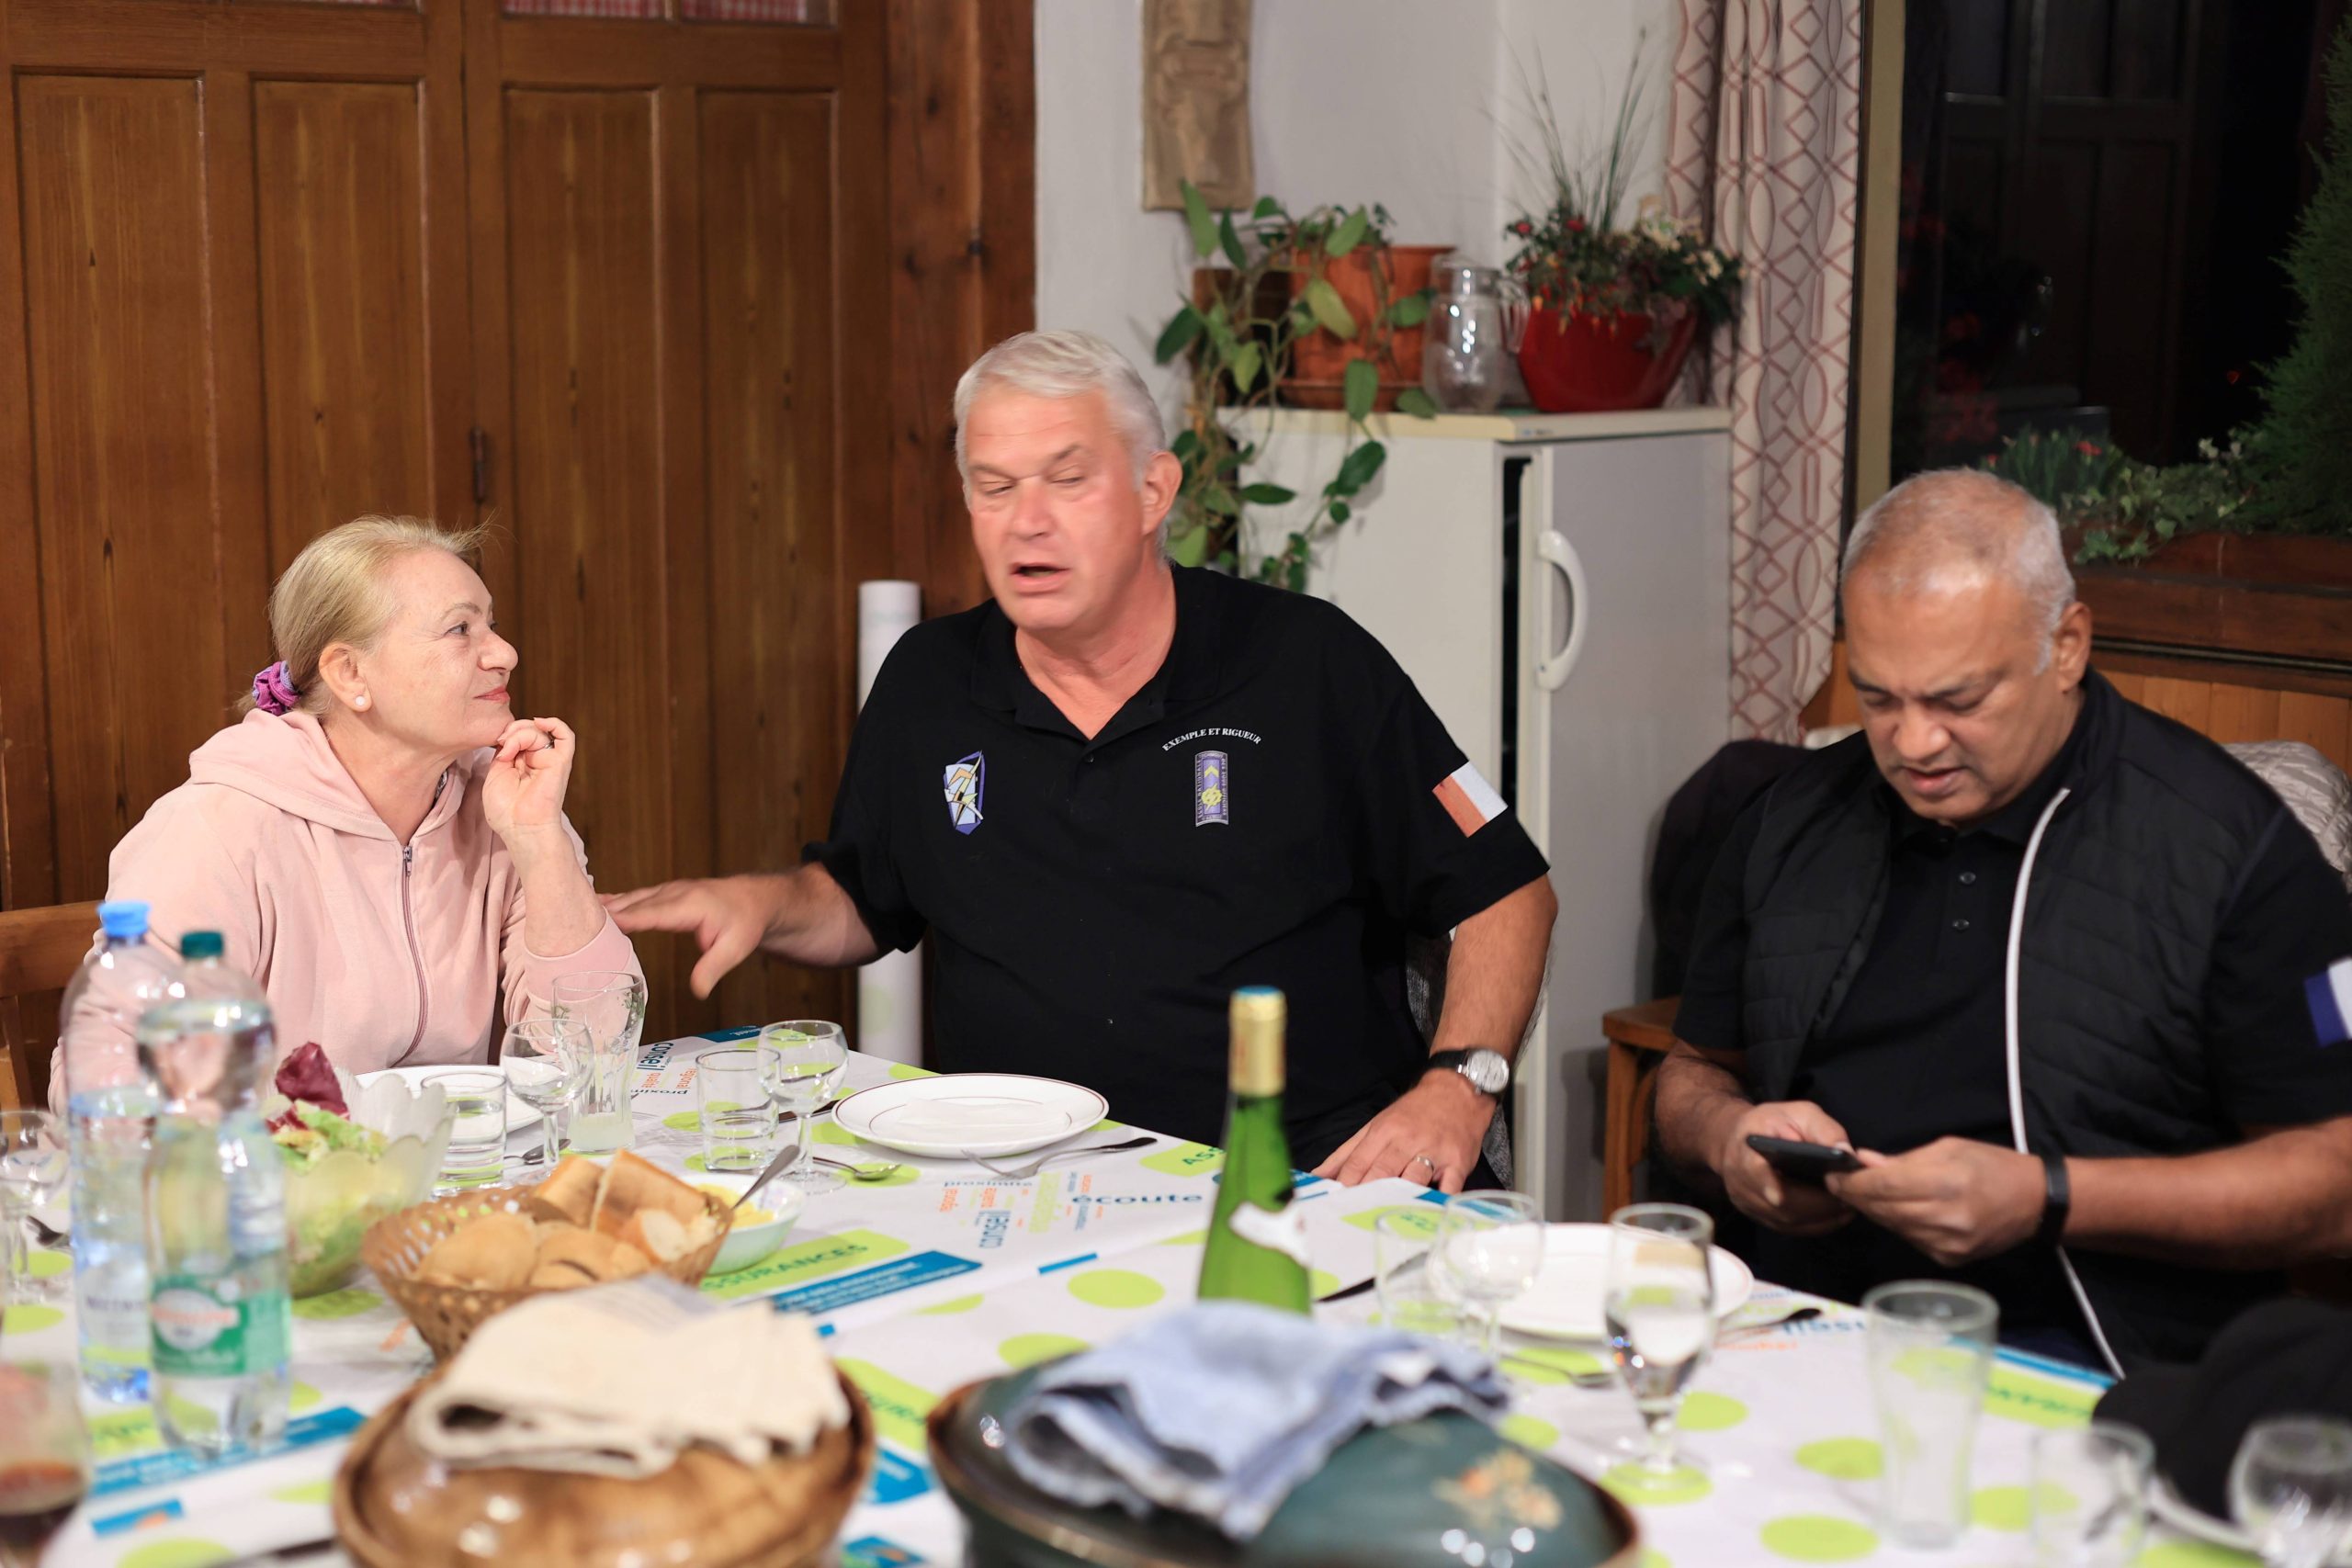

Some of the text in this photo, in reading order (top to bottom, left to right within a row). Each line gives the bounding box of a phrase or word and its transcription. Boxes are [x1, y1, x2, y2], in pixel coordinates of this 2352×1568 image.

[1162, 728, 1262, 751] EXEMPLE ET RIGUEUR
[637, 1043, 674, 1071] conseil
[1072, 1193, 1204, 1204] écoute
[702, 1244, 869, 1292] SSURANCES
